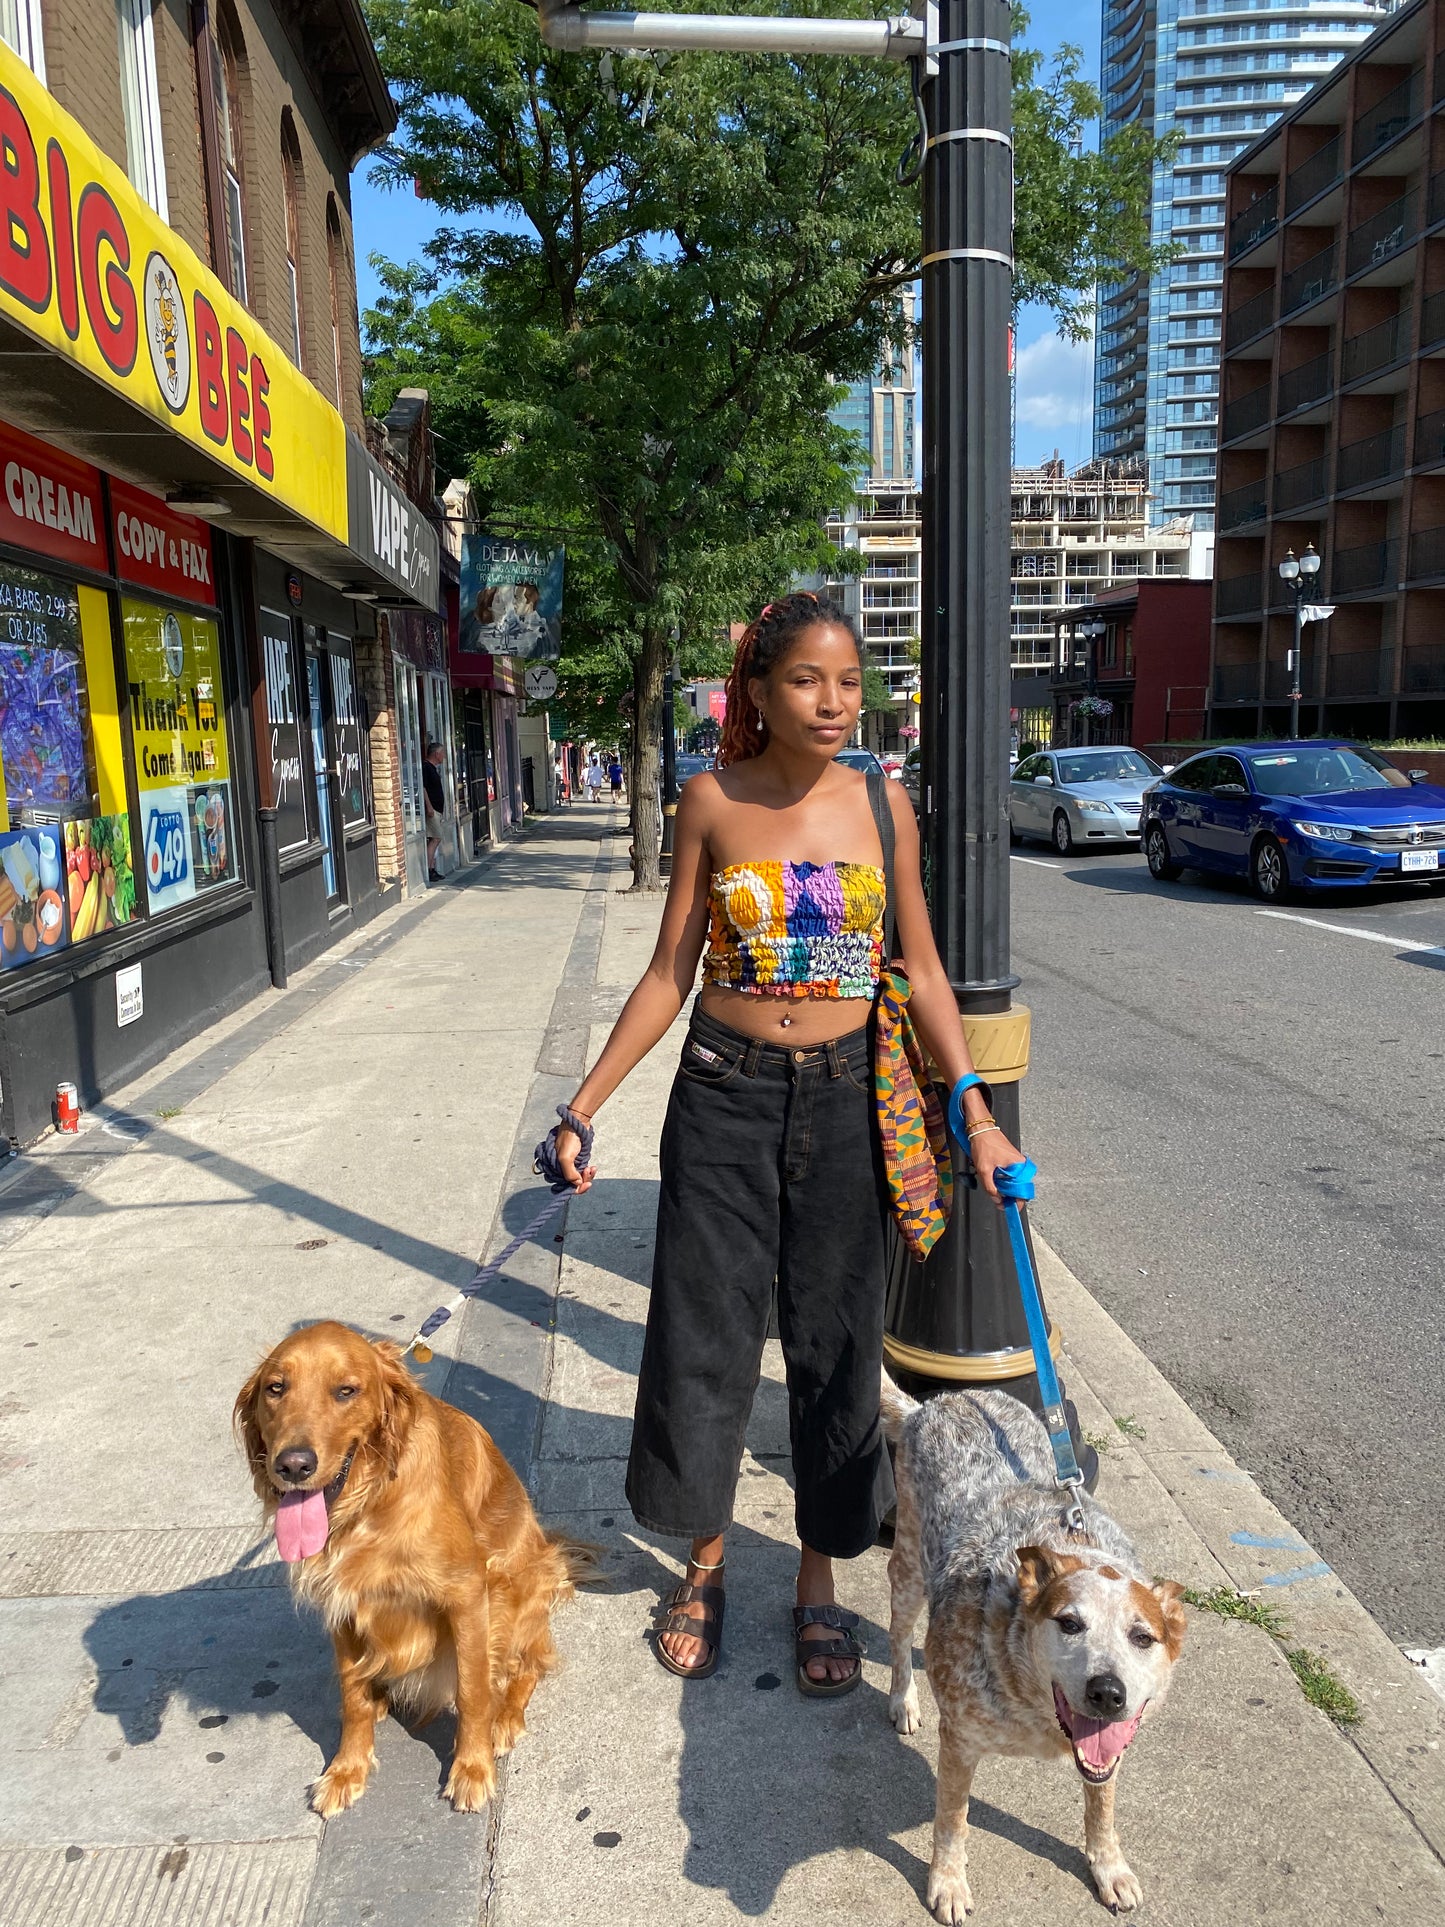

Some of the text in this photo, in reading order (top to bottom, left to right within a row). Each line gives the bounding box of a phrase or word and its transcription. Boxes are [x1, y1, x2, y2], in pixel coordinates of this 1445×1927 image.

[0, 83, 274, 482] BIG BEE
[5, 461, 96, 545] CREAM
[369, 469, 409, 580] VAPE
[117, 511, 211, 585] COPY & FAX
[482, 543, 518, 563] DÉJÀ
[476, 562, 504, 574] CLOTHING
[511, 566, 546, 576] ACCESSORIES
[480, 573, 490, 582] FOR
[491, 574, 515, 584] WOMEN
[522, 577, 538, 586] MEN
[15, 587, 45, 613] BARS:
[46, 595, 66, 619] 2.99
[9, 617, 48, 646] OR 2/$5
[129, 680, 188, 731] Thank
[330, 654, 355, 725] VAPE
[143, 745, 176, 778] Come
[160, 814, 180, 828] LOTTO
